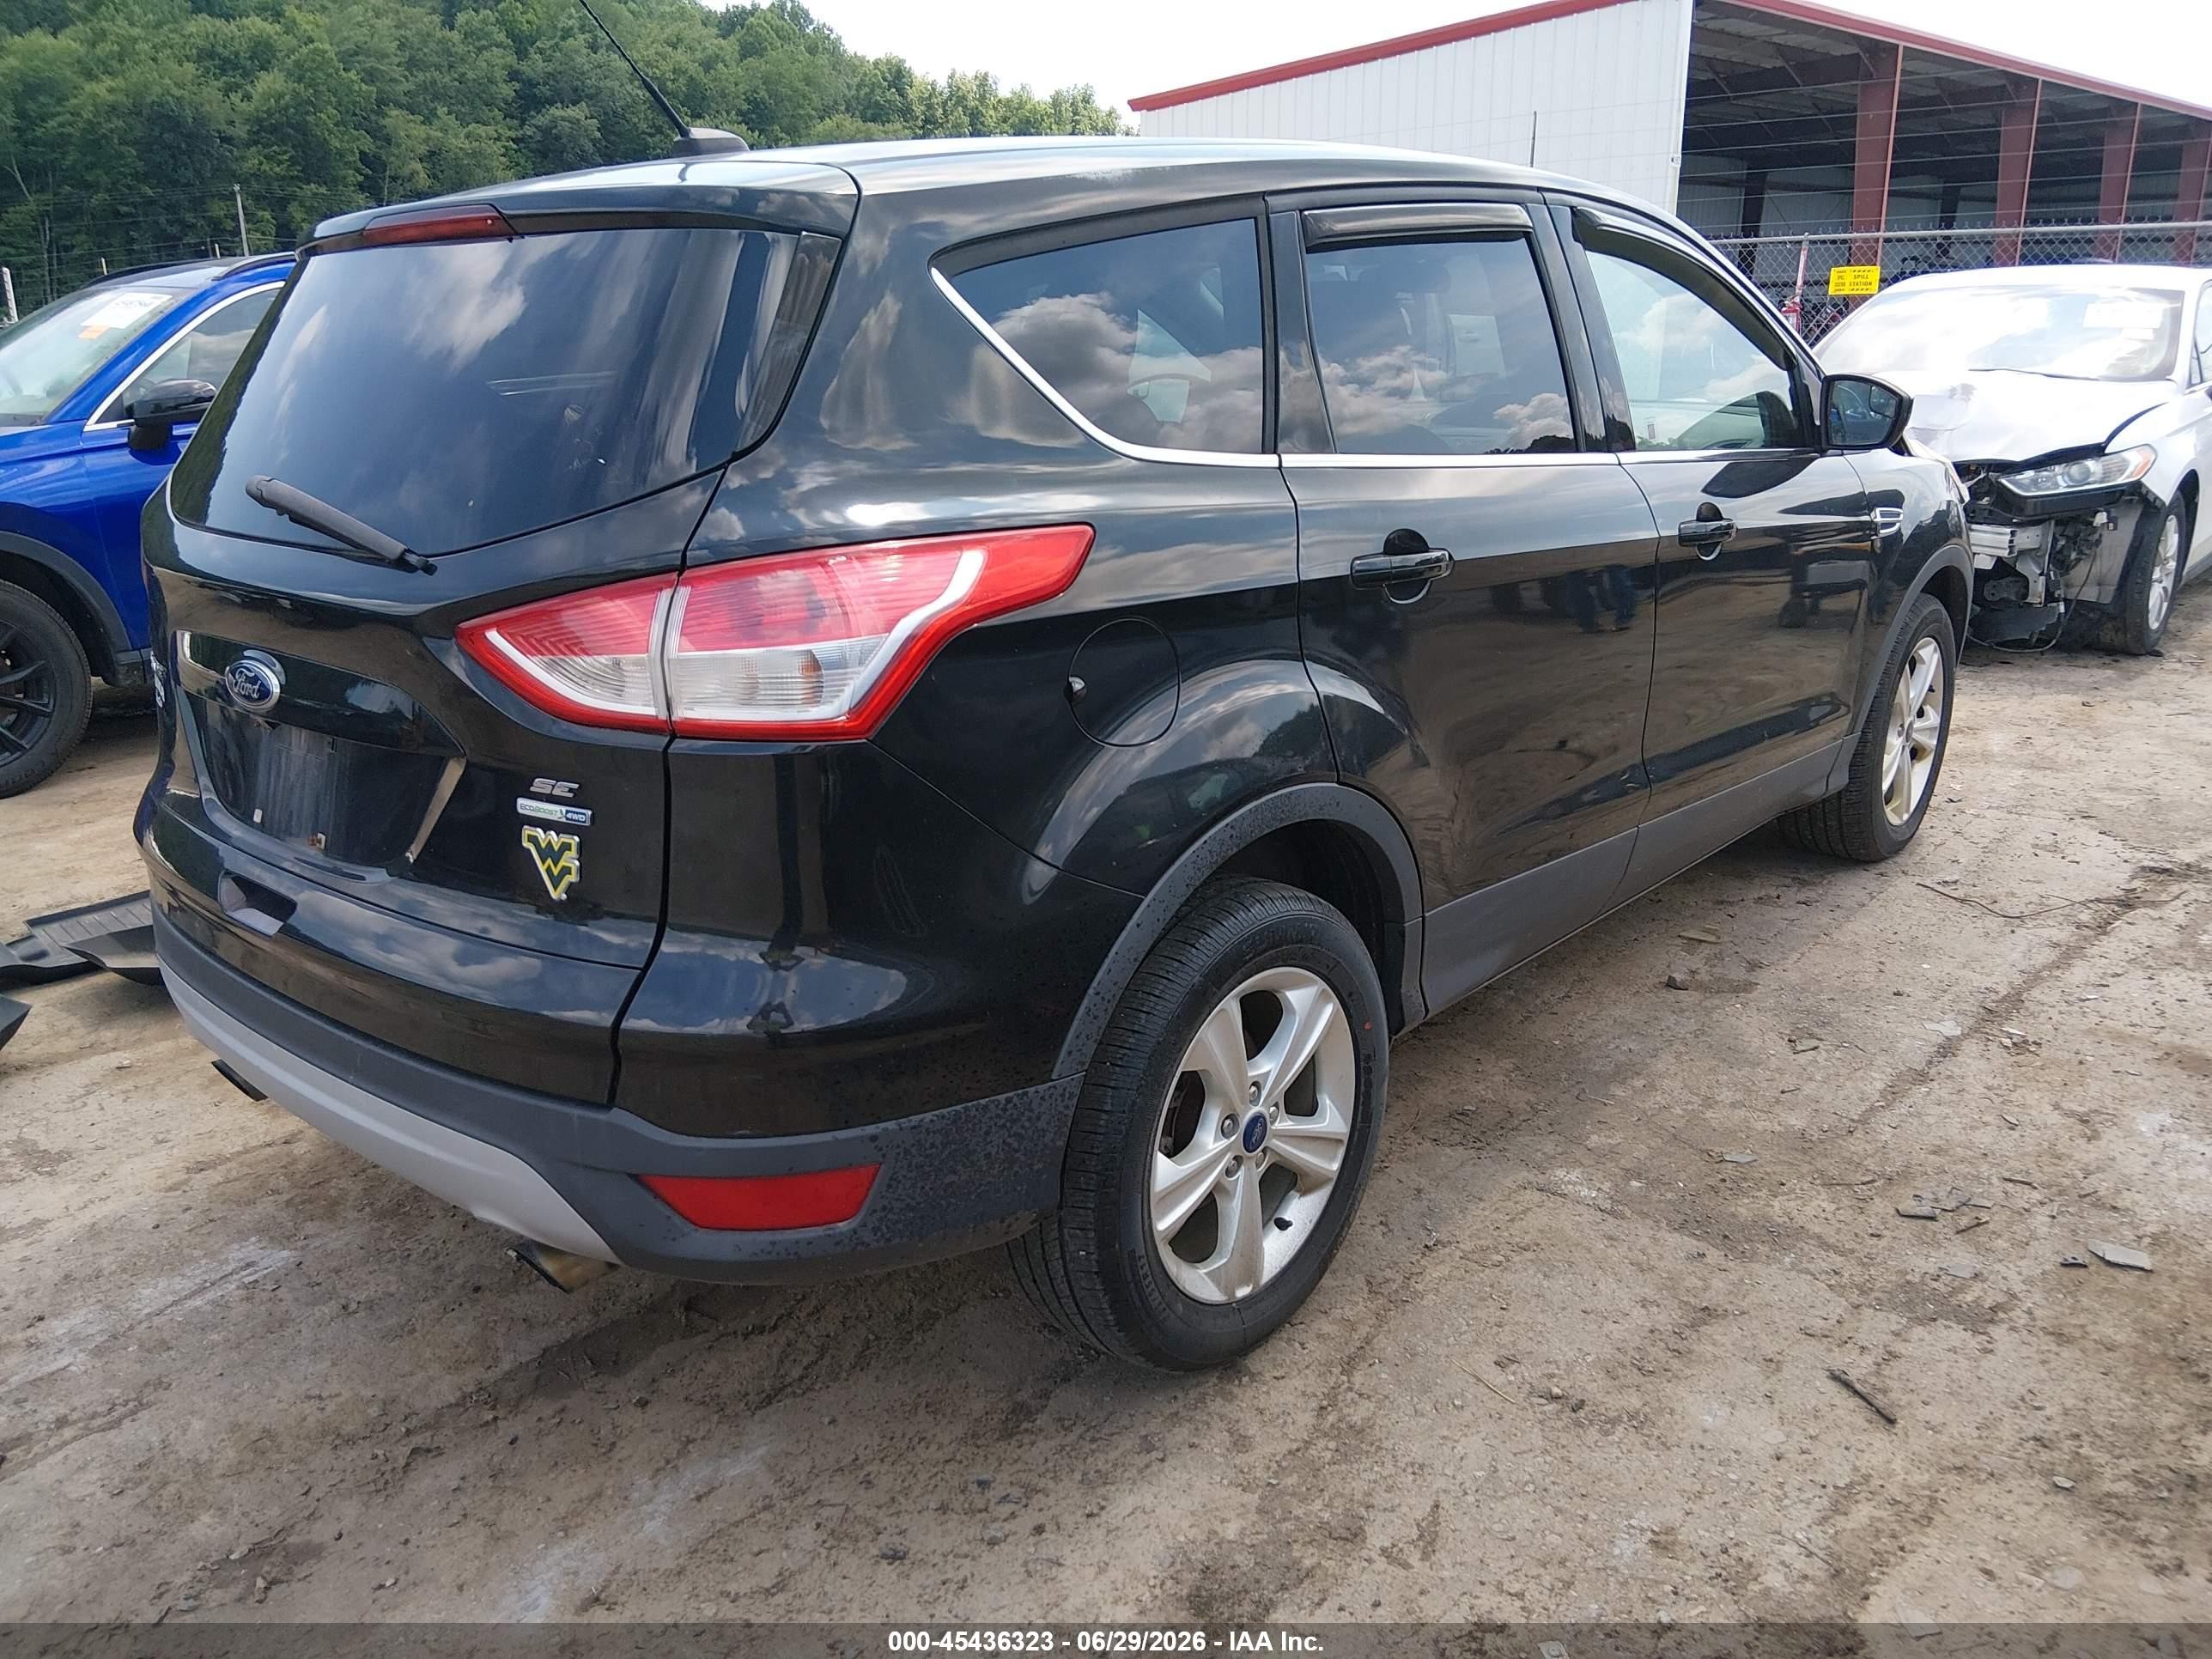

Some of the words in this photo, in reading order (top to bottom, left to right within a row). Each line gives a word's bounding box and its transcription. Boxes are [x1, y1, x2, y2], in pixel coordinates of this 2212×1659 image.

[233, 667, 261, 699] Ford
[529, 777, 580, 798] SE
[520, 803, 559, 817] ECOBOOST
[566, 812, 586, 822] 4WD
